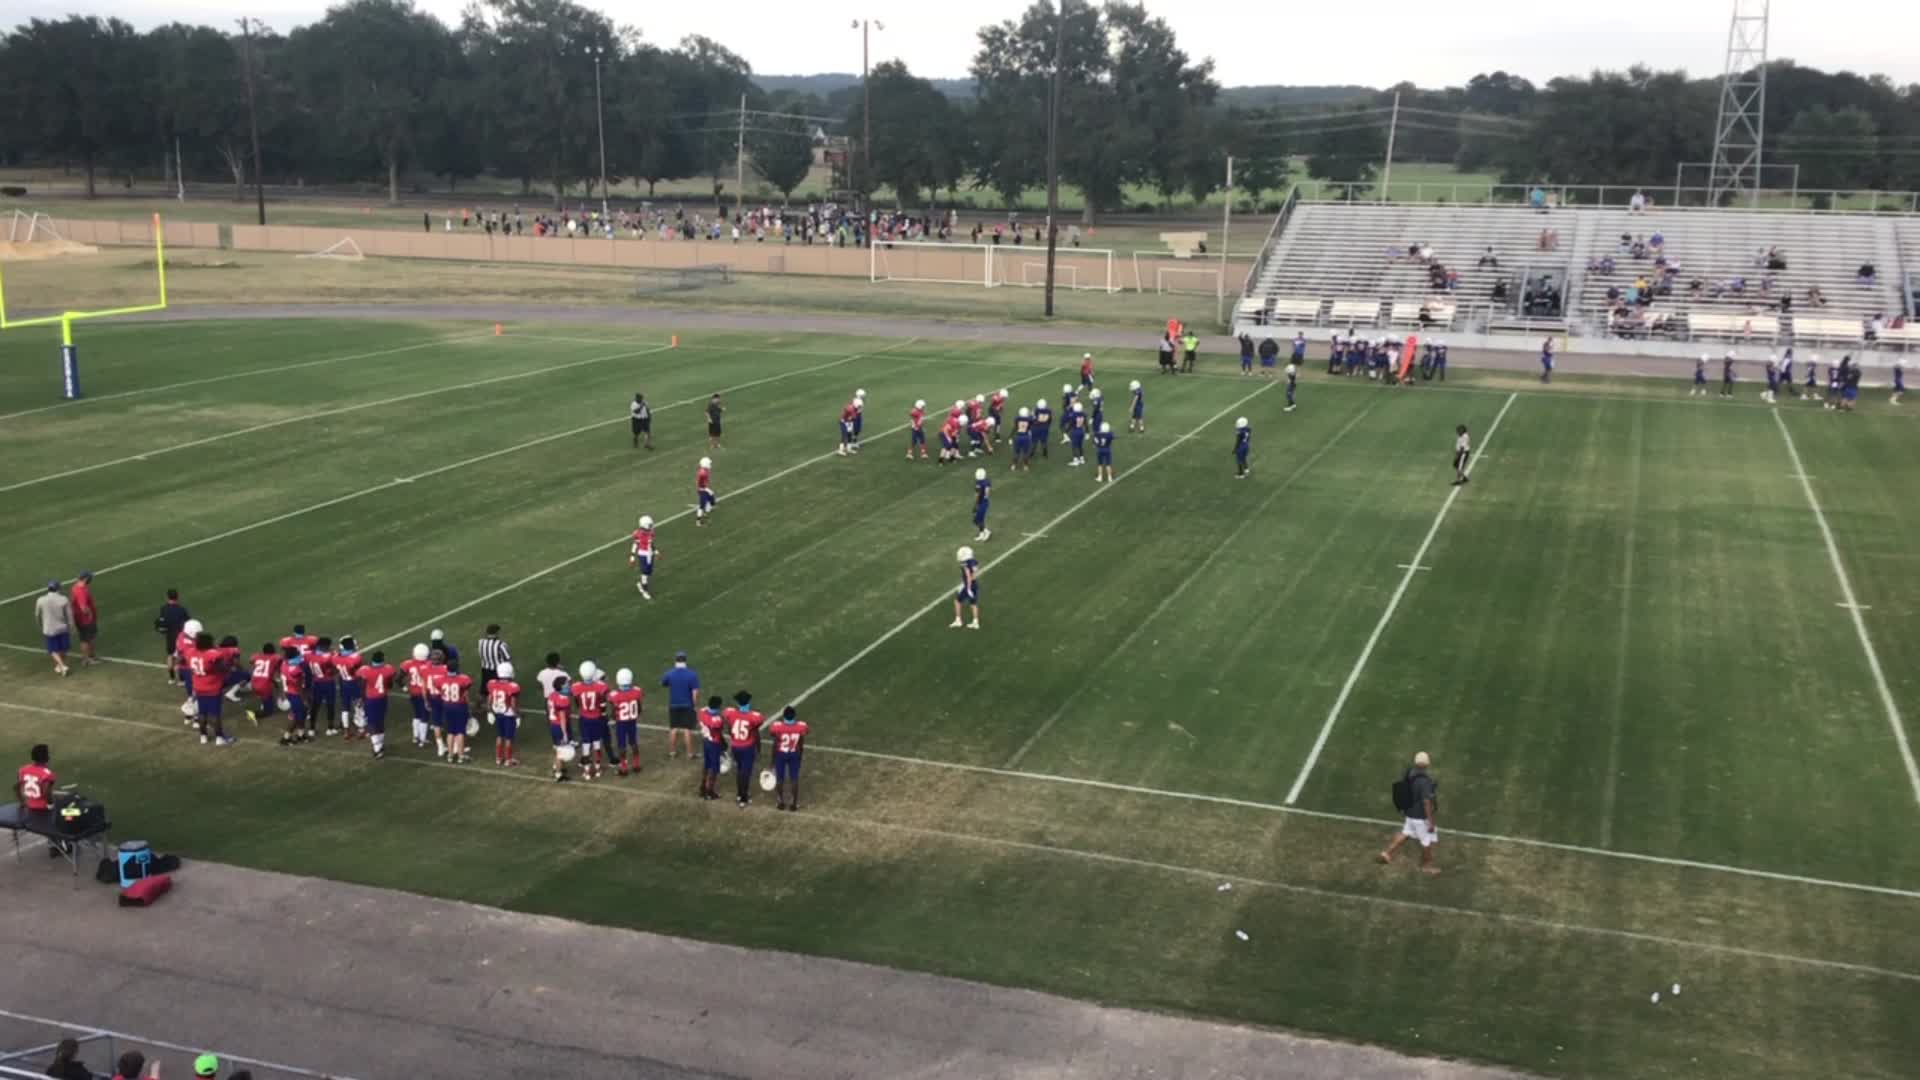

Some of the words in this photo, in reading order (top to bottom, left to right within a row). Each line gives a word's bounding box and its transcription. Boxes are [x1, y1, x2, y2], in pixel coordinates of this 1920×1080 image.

[253, 658, 271, 678] 21
[375, 673, 385, 694] 4
[441, 682, 460, 702] 38
[581, 691, 597, 711] 17
[619, 700, 638, 720] 20
[731, 719, 750, 741] 45
[781, 733, 800, 753] 27
